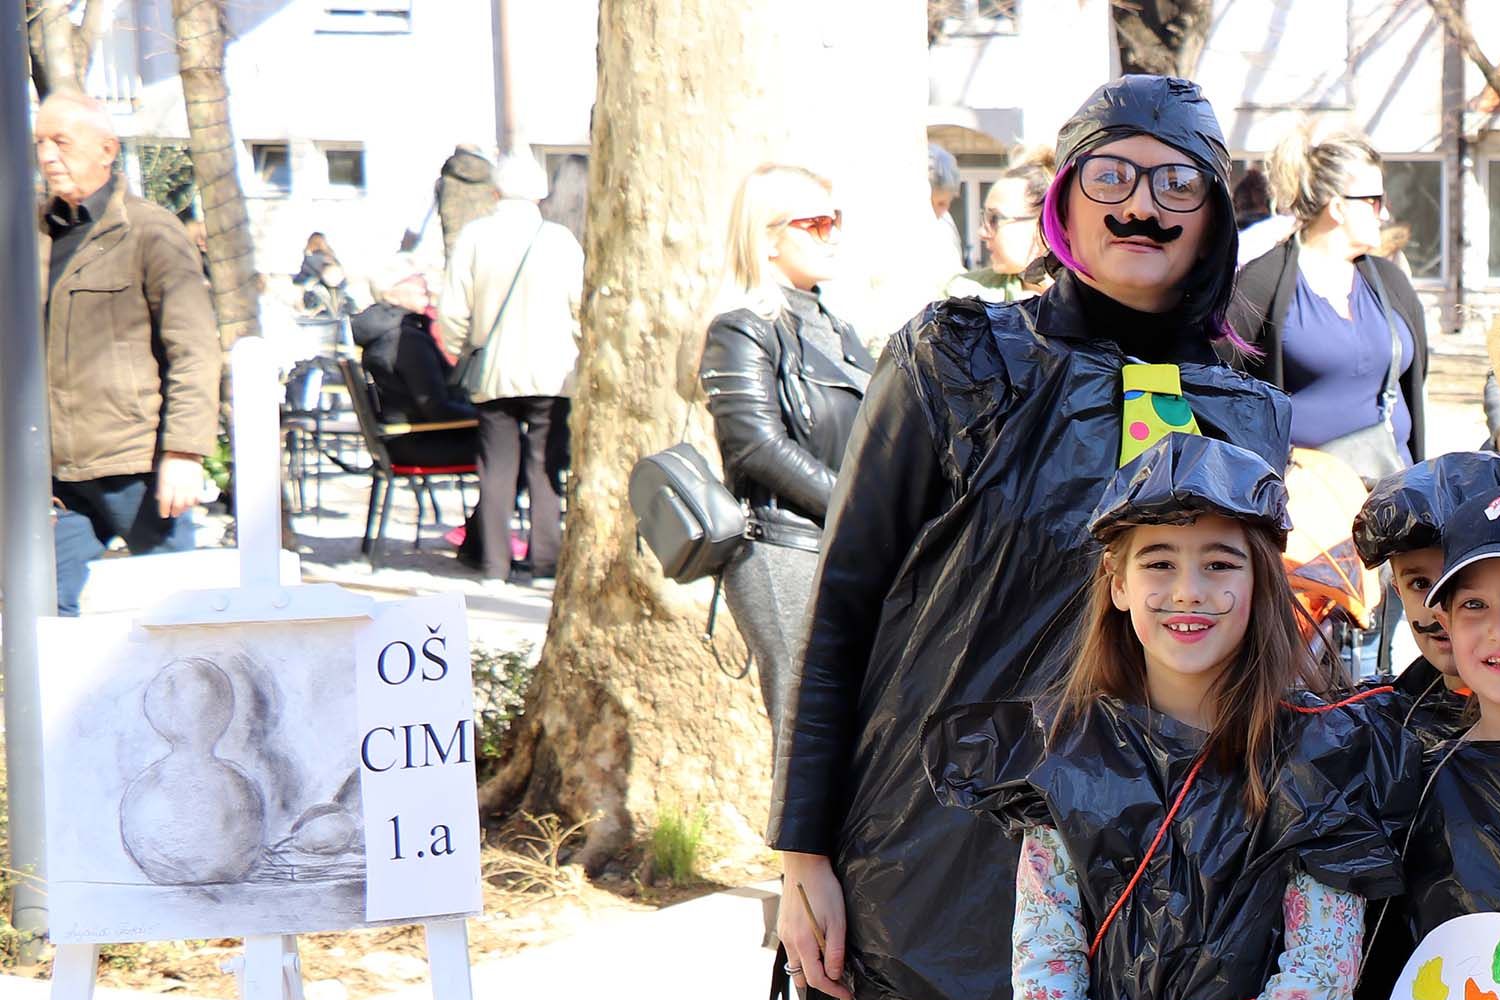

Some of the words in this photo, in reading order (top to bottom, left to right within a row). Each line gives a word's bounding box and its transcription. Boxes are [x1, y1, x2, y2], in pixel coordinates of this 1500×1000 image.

[377, 624, 449, 686] OŠ
[360, 719, 472, 773] CIM
[389, 815, 456, 861] 1.a
